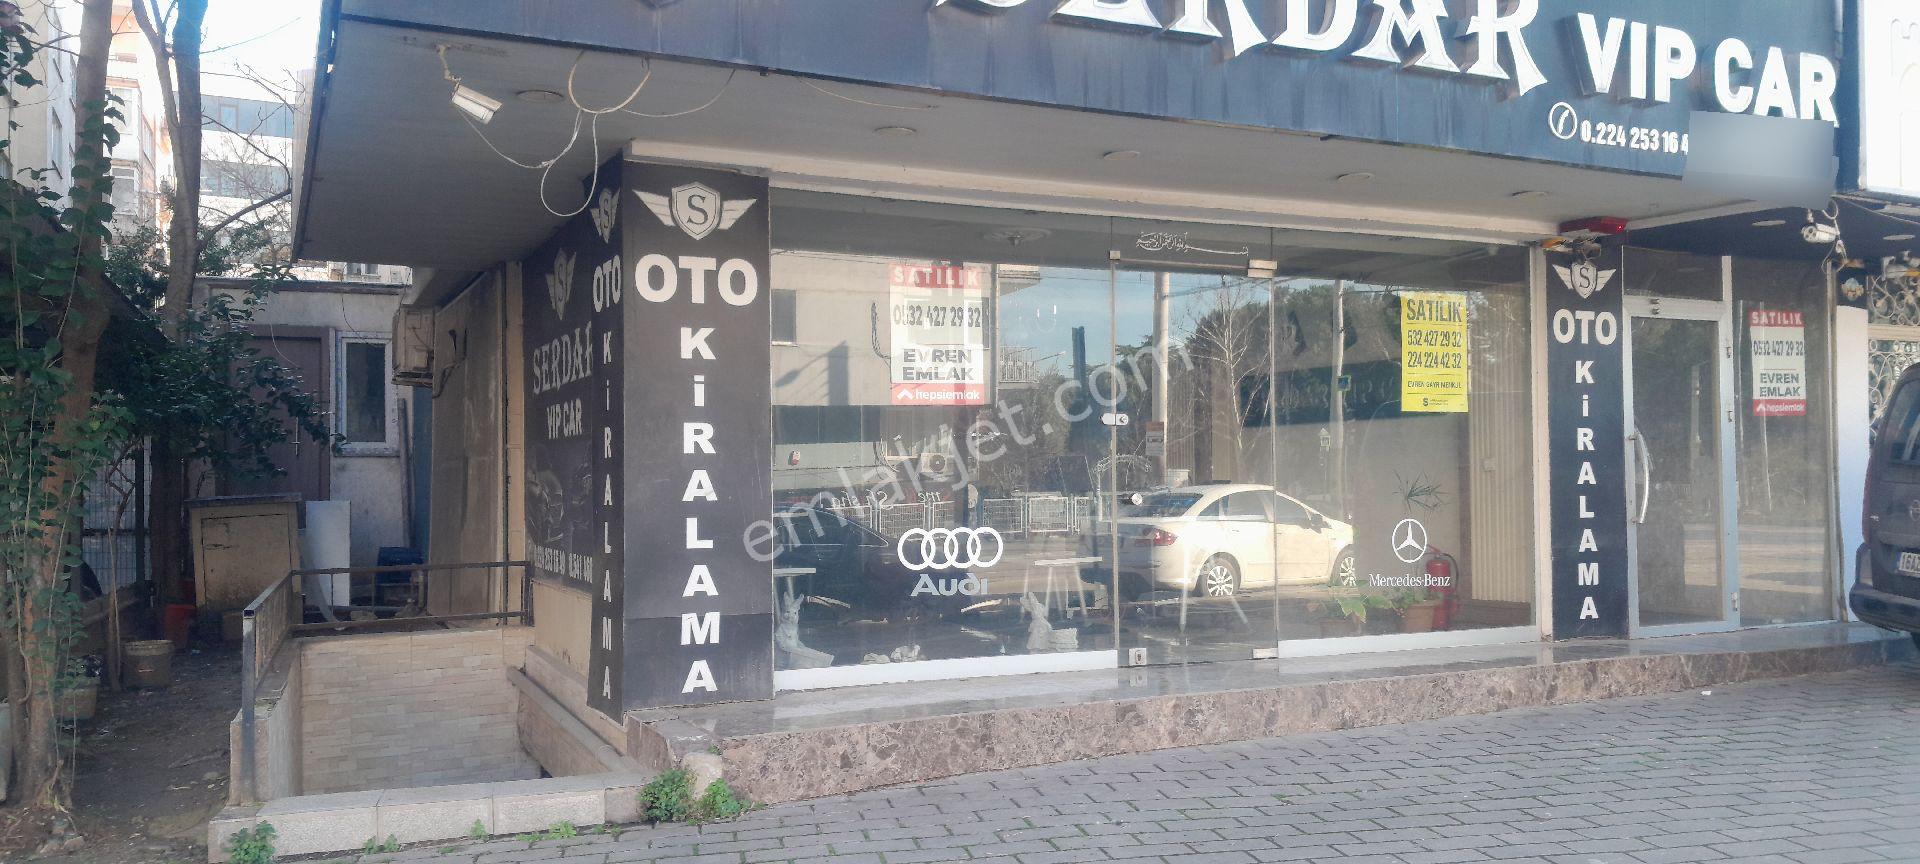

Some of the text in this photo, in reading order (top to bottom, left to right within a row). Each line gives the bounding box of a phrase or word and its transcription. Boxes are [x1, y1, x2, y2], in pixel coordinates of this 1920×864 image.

[935, 0, 1839, 128] DAR VIP CAR
[1581, 119, 1626, 147] 0.224
[1629, 126, 1660, 151] 253
[1661, 130, 1679, 154] 16
[687, 194, 709, 225] S
[592, 255, 622, 312] OTO
[635, 253, 758, 306] OTO
[894, 266, 979, 286] SATILIK
[1579, 266, 1591, 289] S
[893, 304, 981, 328] 0532 427 29 32
[1407, 299, 1462, 322] SATILIK
[1751, 311, 1802, 325] SATILIK
[1553, 308, 1617, 345] OTO
[1407, 330, 1461, 347] 532 427 29 32
[1772, 340, 1784, 356] 427
[1786, 340, 1793, 356] 29
[1796, 340, 1804, 356] 32
[903, 349, 973, 364] EVREN
[1407, 351, 1461, 369] 224 224 42 32
[902, 366, 974, 381] EMLAK
[1760, 373, 1799, 384] EVREN
[915, 389, 980, 402] hepsiemlak
[1760, 387, 1801, 397] EMLAK
[547, 398, 582, 439] VIP CAR
[910, 573, 988, 597] Audi
[1368, 573, 1451, 587] Mercedes-Benz
